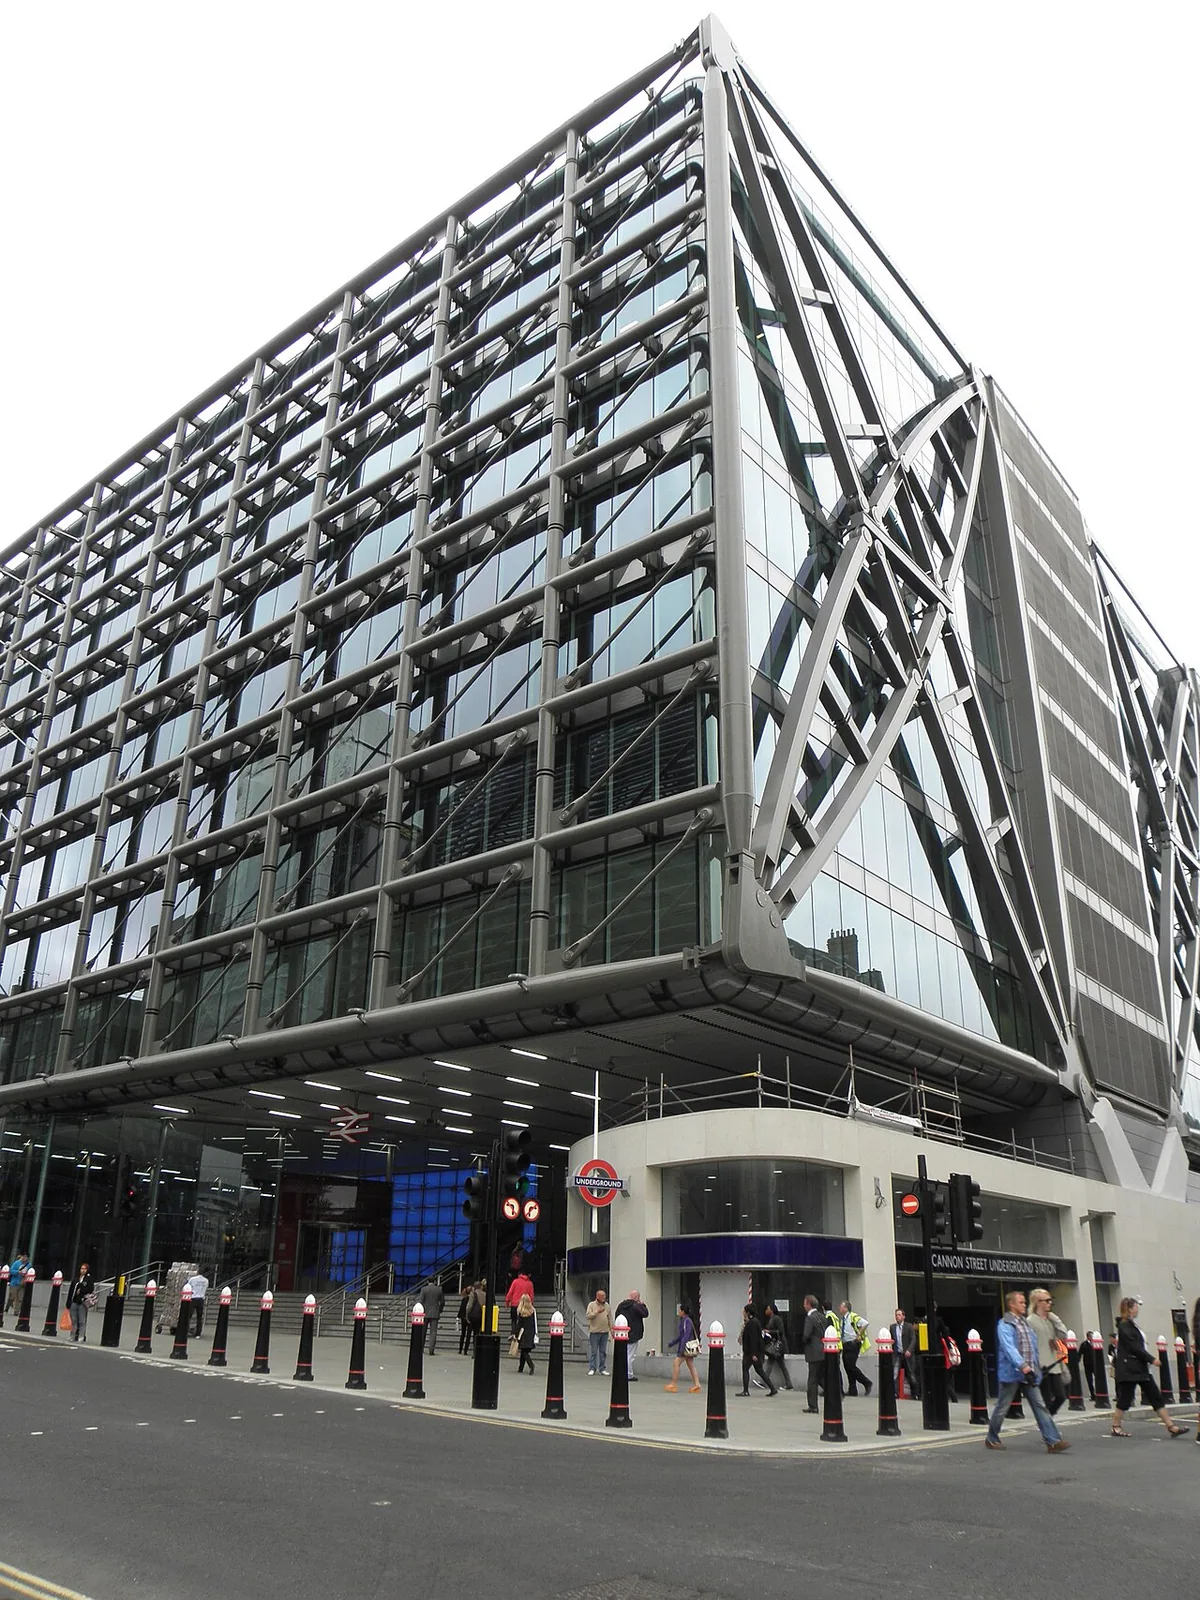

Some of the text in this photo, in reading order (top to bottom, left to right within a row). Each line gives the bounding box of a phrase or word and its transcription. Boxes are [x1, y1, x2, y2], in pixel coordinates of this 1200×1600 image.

[576, 1177, 622, 1188] UNDERGROUND
[931, 1253, 1057, 1275] CANNON STREET UNDERGROUND STATION
